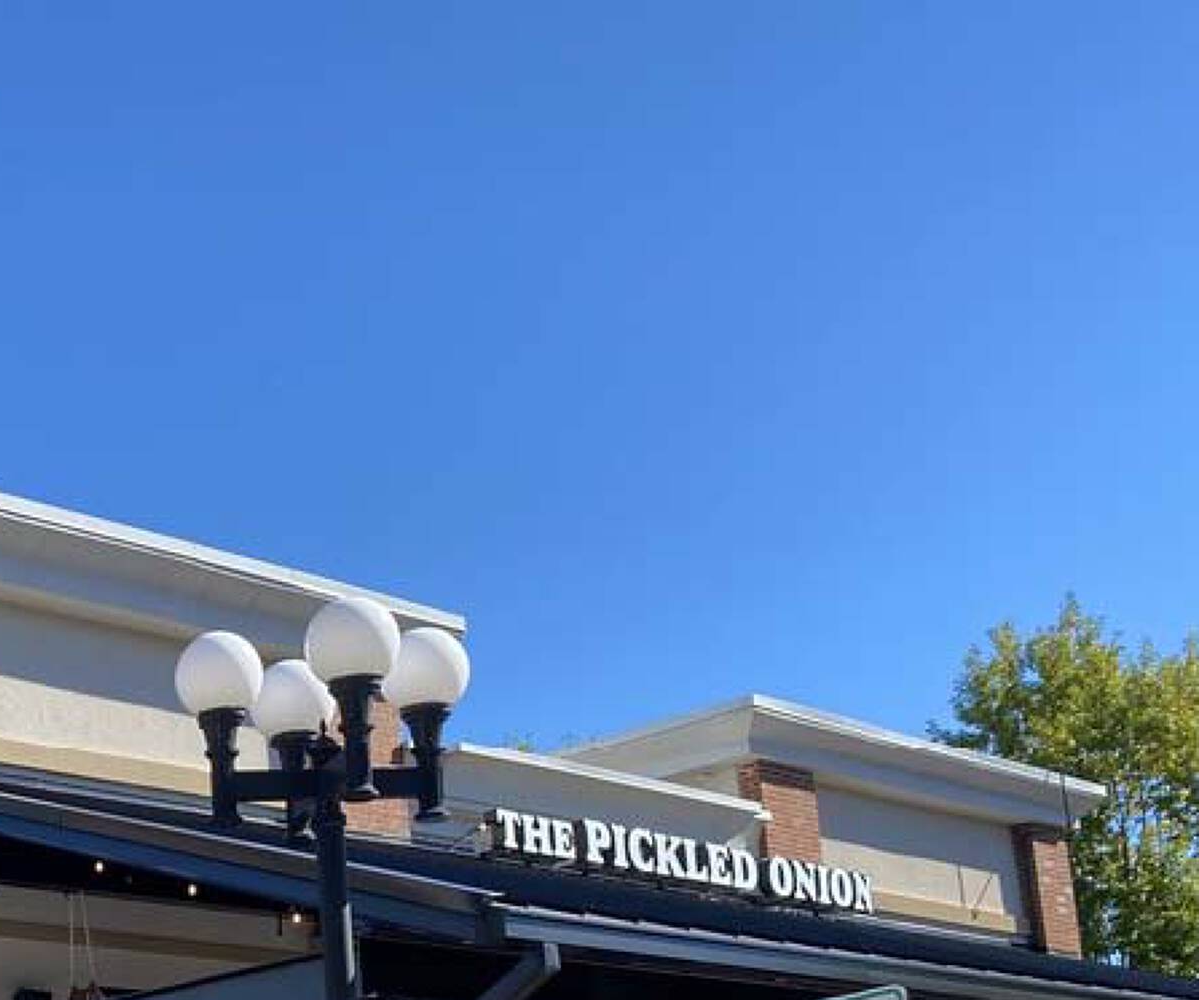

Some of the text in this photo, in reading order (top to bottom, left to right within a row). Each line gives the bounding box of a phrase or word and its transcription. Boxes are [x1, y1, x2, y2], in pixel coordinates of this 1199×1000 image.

[496, 808, 874, 914] THE PICKLED ONION
